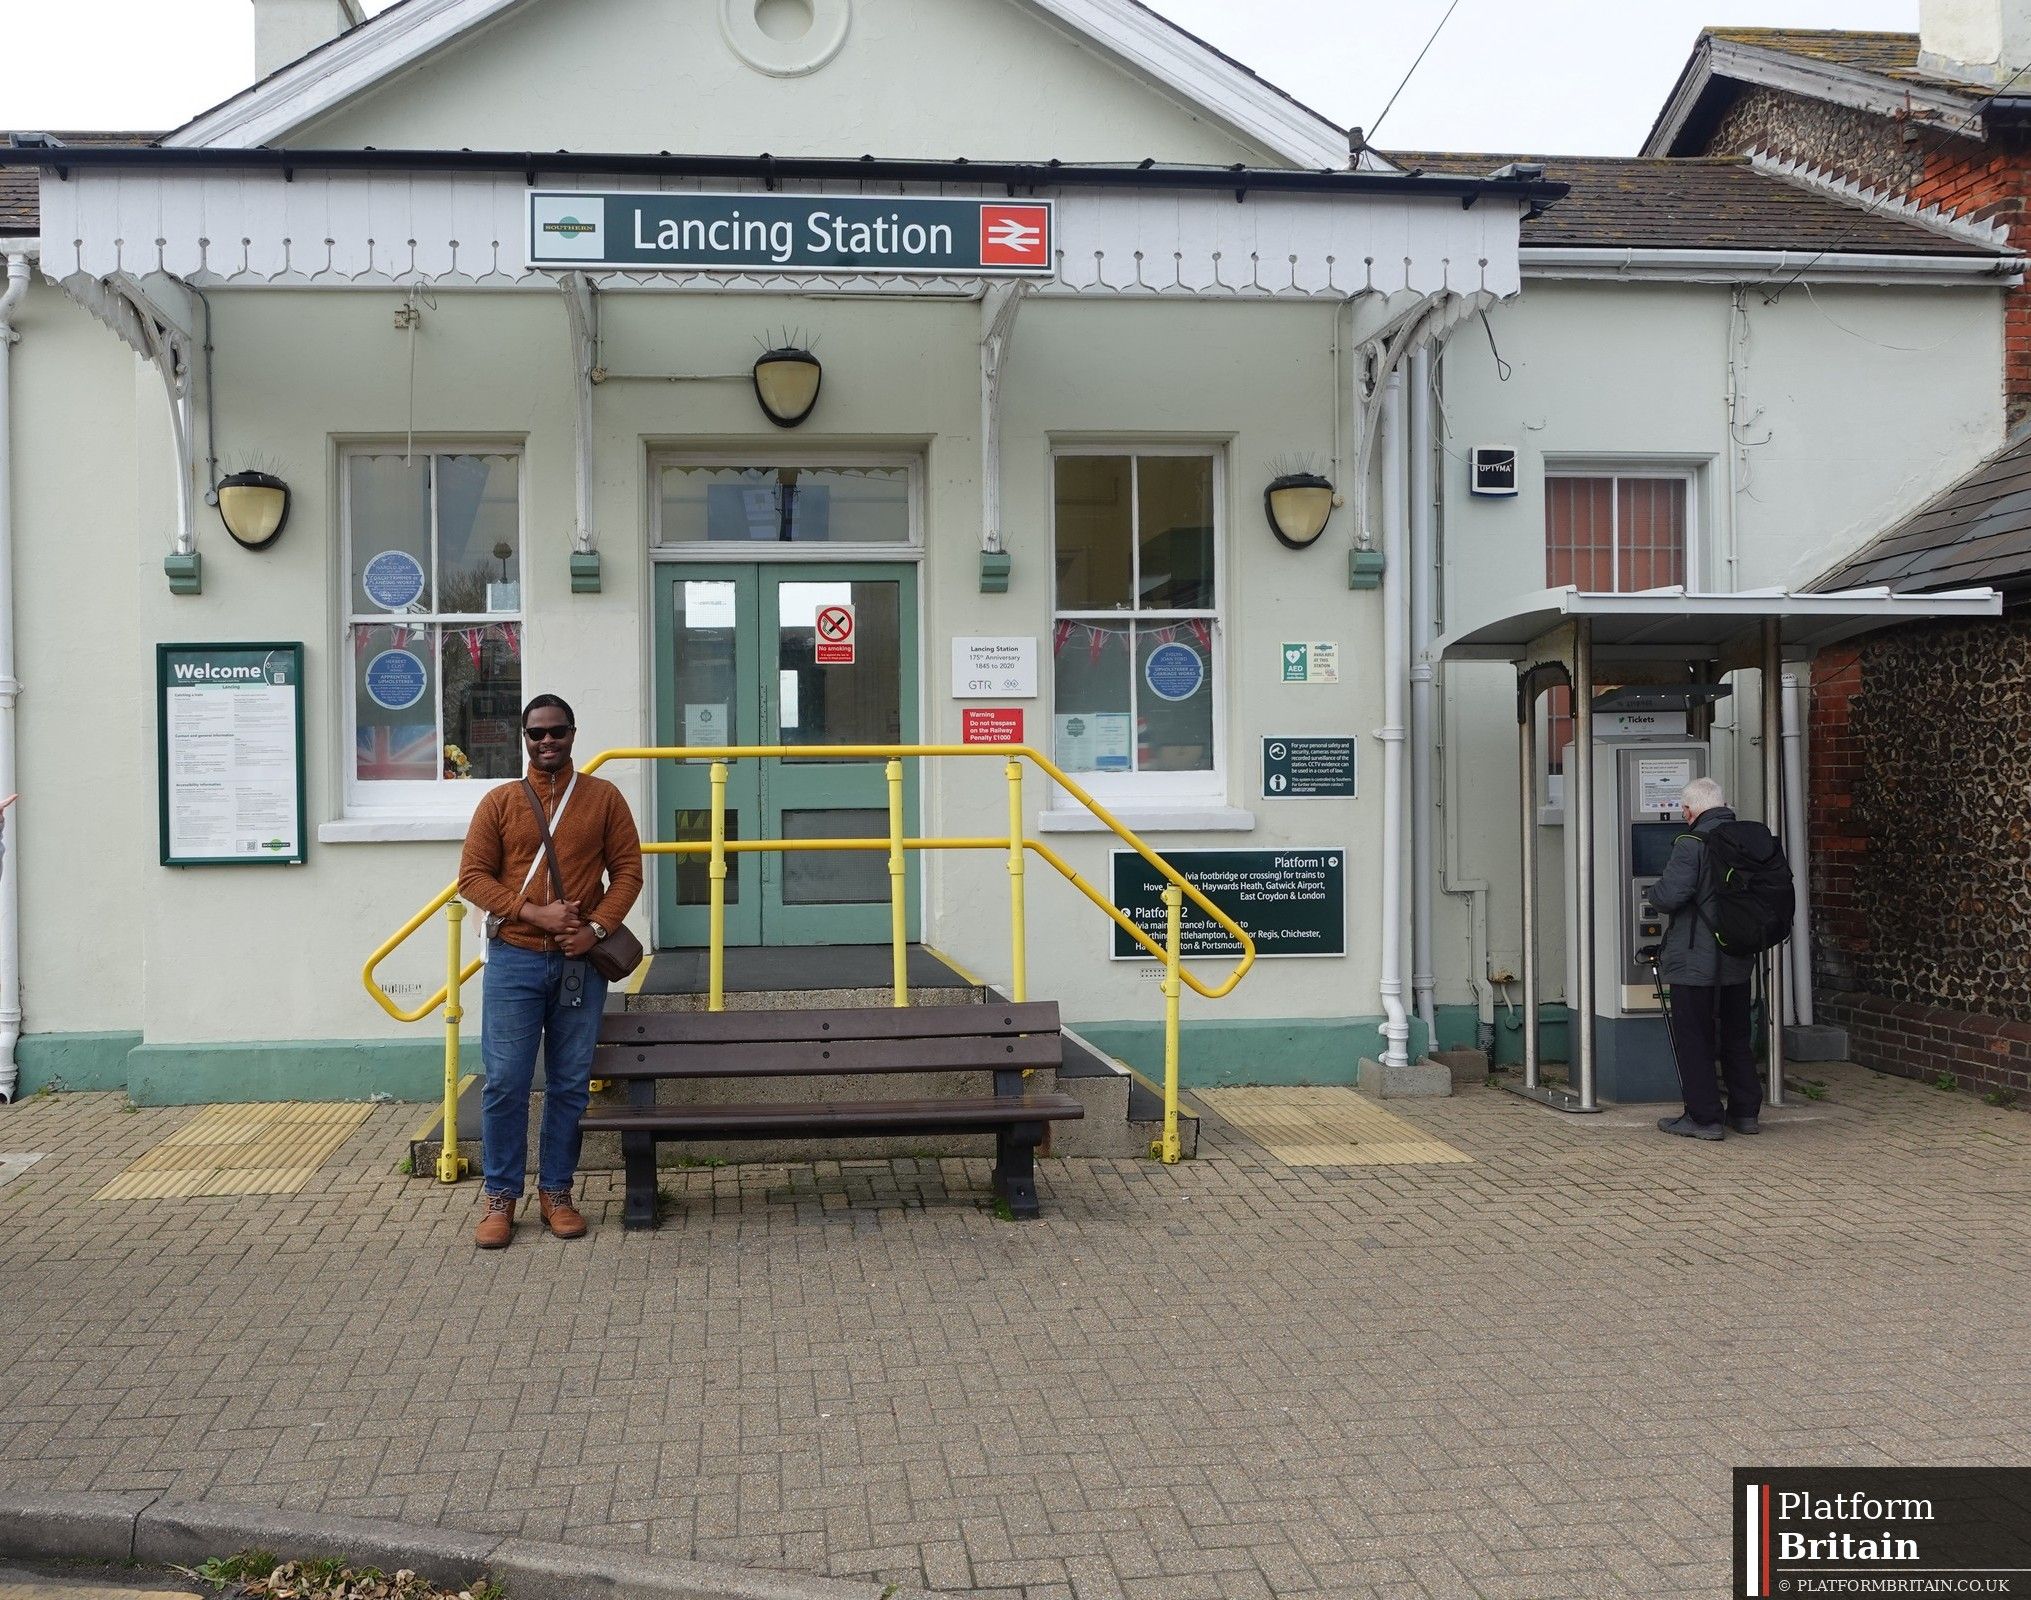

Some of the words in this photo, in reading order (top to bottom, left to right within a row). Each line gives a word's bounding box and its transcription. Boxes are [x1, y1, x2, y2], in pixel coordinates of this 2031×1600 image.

[634, 210, 793, 263] Lancing
[806, 211, 953, 255] Station
[174, 663, 261, 678] Welcome
[969, 680, 992, 690] GTR
[1275, 857, 1318, 868] Platform
[1321, 857, 1324, 868] 1
[1200, 872, 1238, 881] footbridge
[1249, 872, 1281, 880] crossing)
[1202, 882, 1239, 892] Haywards
[1241, 882, 1264, 890] Heath,
[1266, 882, 1296, 890] Gatwick
[1297, 881, 1325, 890] Airport,
[1240, 892, 1256, 900] East
[1257, 892, 1288, 902] Croydon
[1136, 907, 1168, 918] Platfor
[1181, 907, 1188, 918] 2
[1180, 921, 1204, 929] trance)
[1181, 931, 1228, 940] ttlehampton,
[1258, 931, 1279, 940] Regis,
[1281, 930, 1320, 938] Chichester,
